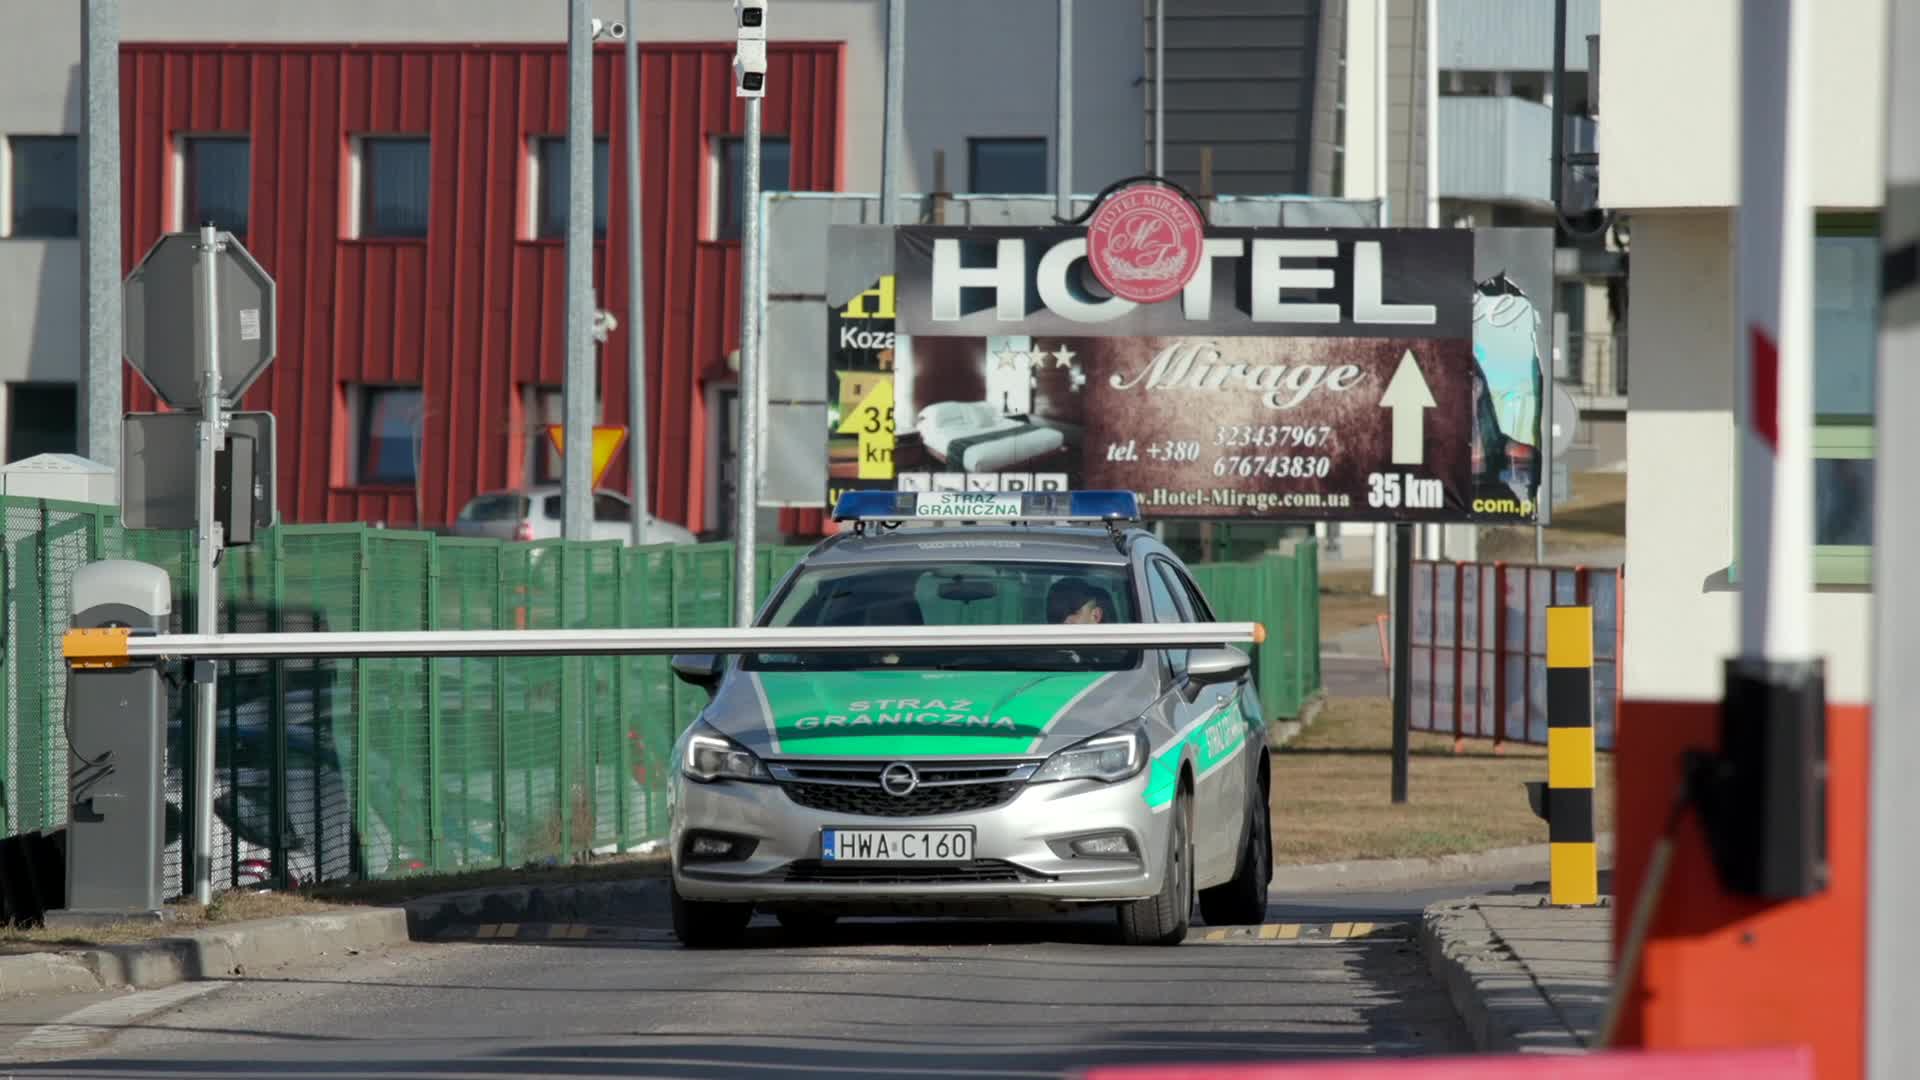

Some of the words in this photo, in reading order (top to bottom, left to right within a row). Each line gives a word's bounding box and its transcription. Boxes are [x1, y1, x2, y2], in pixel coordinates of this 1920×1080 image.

[932, 237, 1437, 324] HOTEL
[1109, 341, 1366, 410] Mirage
[1213, 426, 1330, 447] 323437967
[1106, 440, 1139, 461] tel.
[1147, 440, 1200, 461] +380
[1213, 456, 1330, 477] 676743830
[1368, 473, 1401, 508] 35
[1405, 474, 1444, 508] km
[918, 504, 1018, 516] GRANICZNA
[795, 711, 1016, 731] GRANICZNA
[840, 833, 890, 858] HWA
[902, 833, 966, 858] C160
